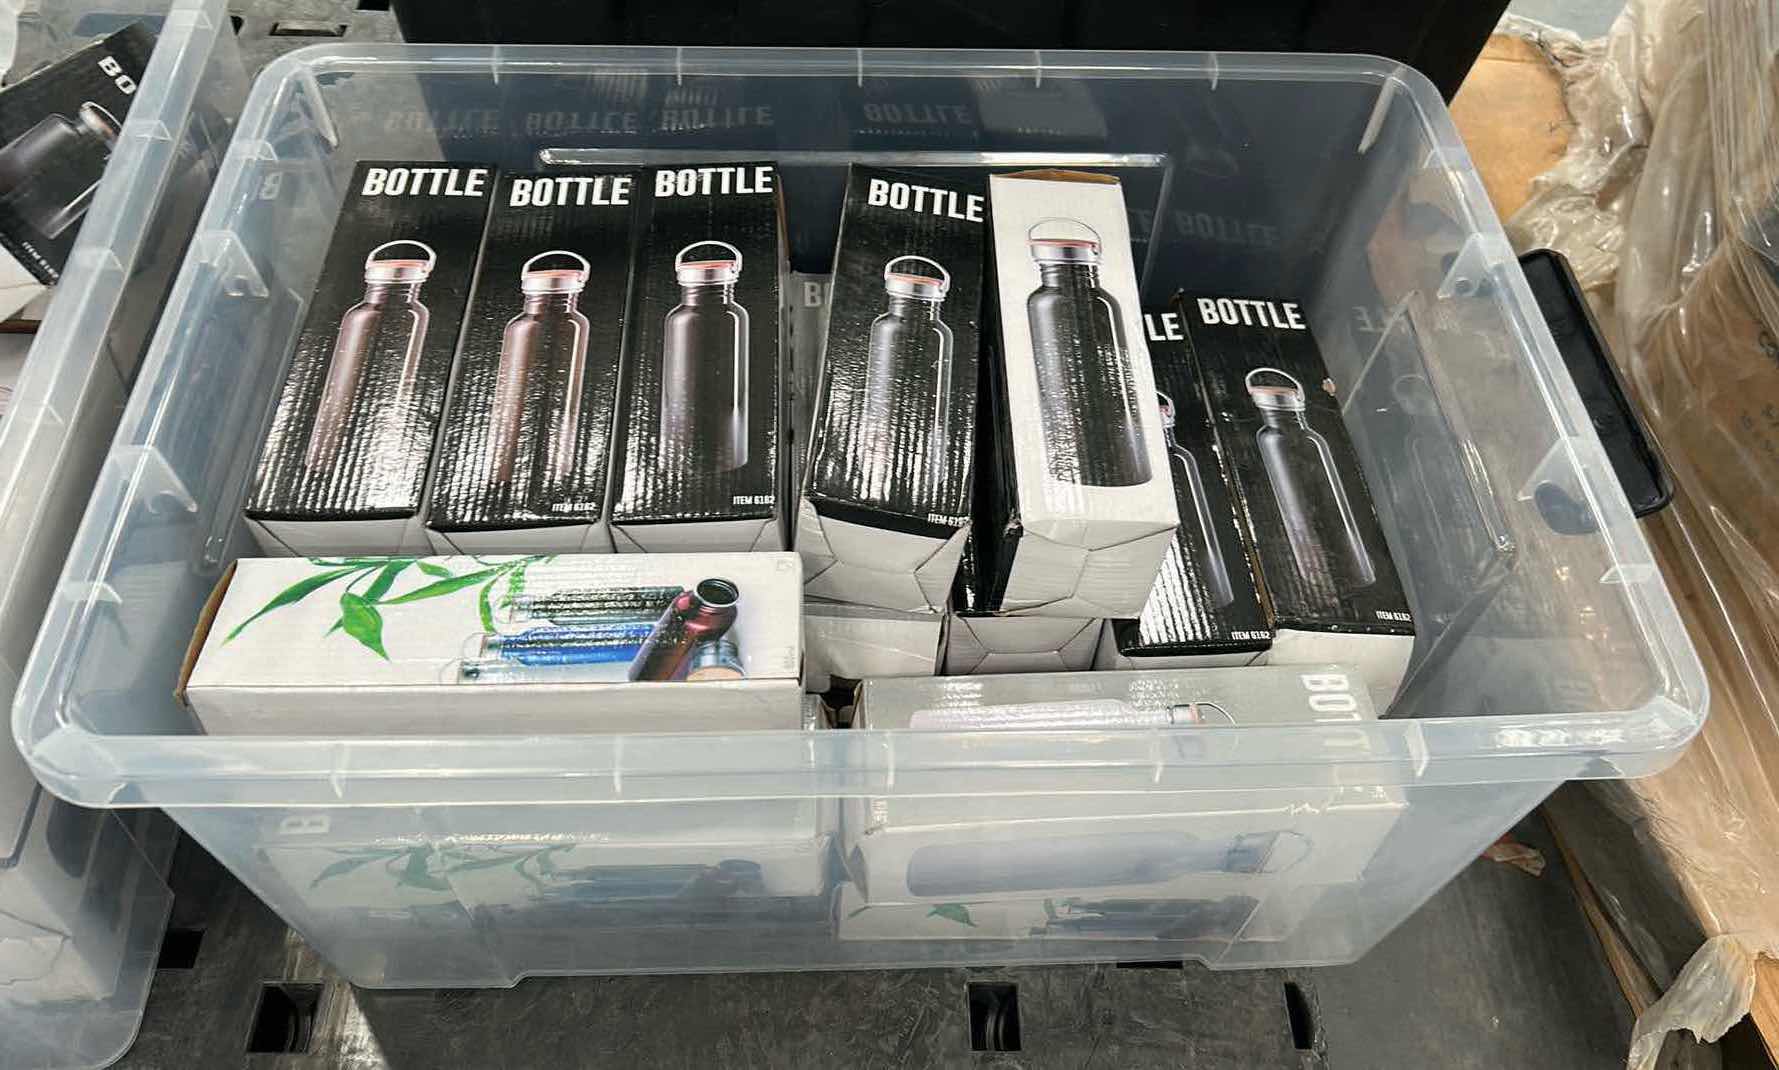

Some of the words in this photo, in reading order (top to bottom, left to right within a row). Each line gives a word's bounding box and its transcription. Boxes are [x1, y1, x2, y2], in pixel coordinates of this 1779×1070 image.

[362, 167, 488, 197] BOTTLE
[510, 176, 632, 207] BOTTLE
[655, 166, 774, 197] BOTTLE
[868, 178, 985, 222] BOTTLE
[1143, 312, 1184, 341] LE
[1197, 298, 1306, 330] BOTTLE
[551, 502, 573, 512] ITEM
[733, 495, 753, 505] ITEM
[753, 494, 776, 505] 6162
[928, 513, 948, 525] ITEM
[1376, 610, 1393, 620] ITEM
[1231, 631, 1250, 640] ITEM
